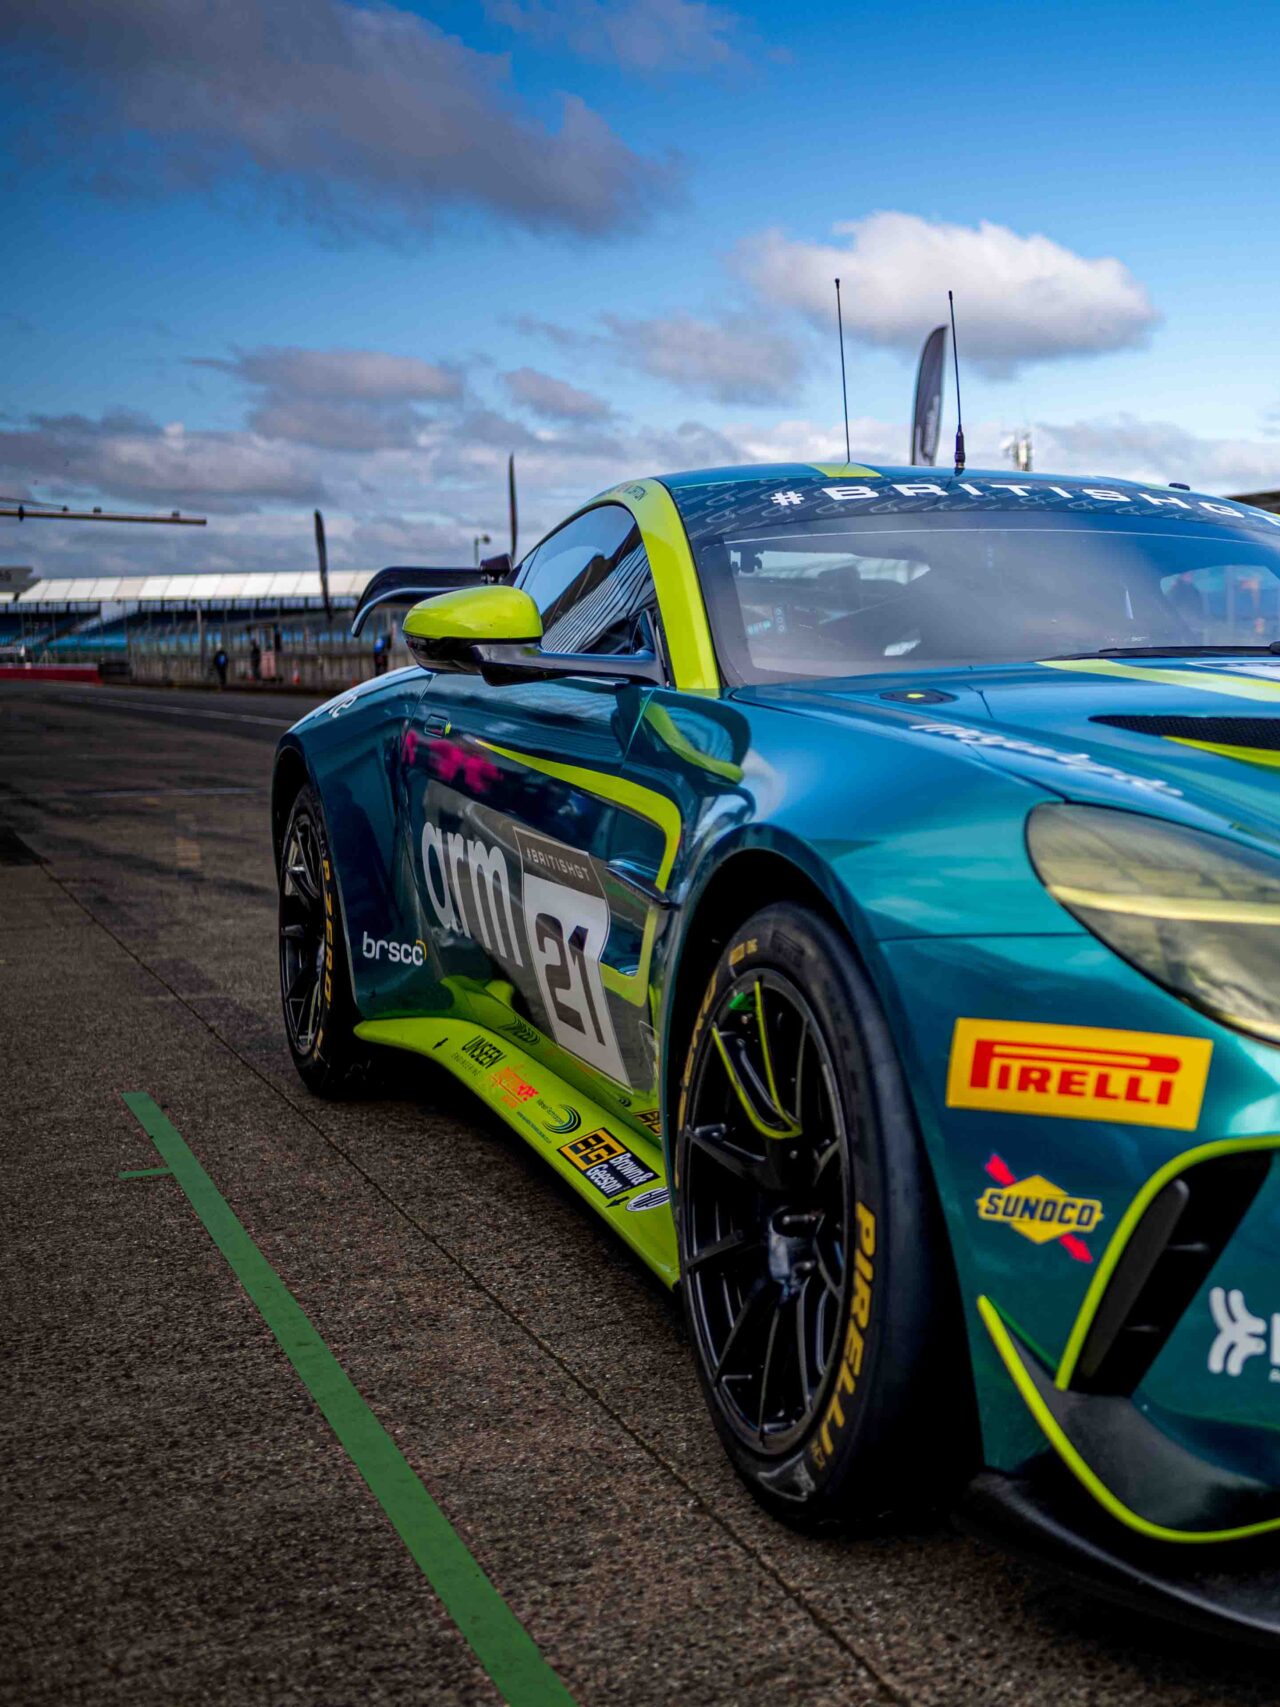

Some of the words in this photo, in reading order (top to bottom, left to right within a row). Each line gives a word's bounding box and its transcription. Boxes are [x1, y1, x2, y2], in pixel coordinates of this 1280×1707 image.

[525, 847, 592, 882] #BRITISHGT
[421, 821, 524, 968] arm
[362, 931, 425, 967] brscc
[535, 912, 607, 1047] 21
[462, 1035, 507, 1069] UNSEEN
[968, 1038, 1182, 1106] PIRELLI
[586, 1163, 623, 1194] Geeson
[984, 1193, 1096, 1227] SUNOCO
[819, 1201, 877, 1456] PIRELLI
